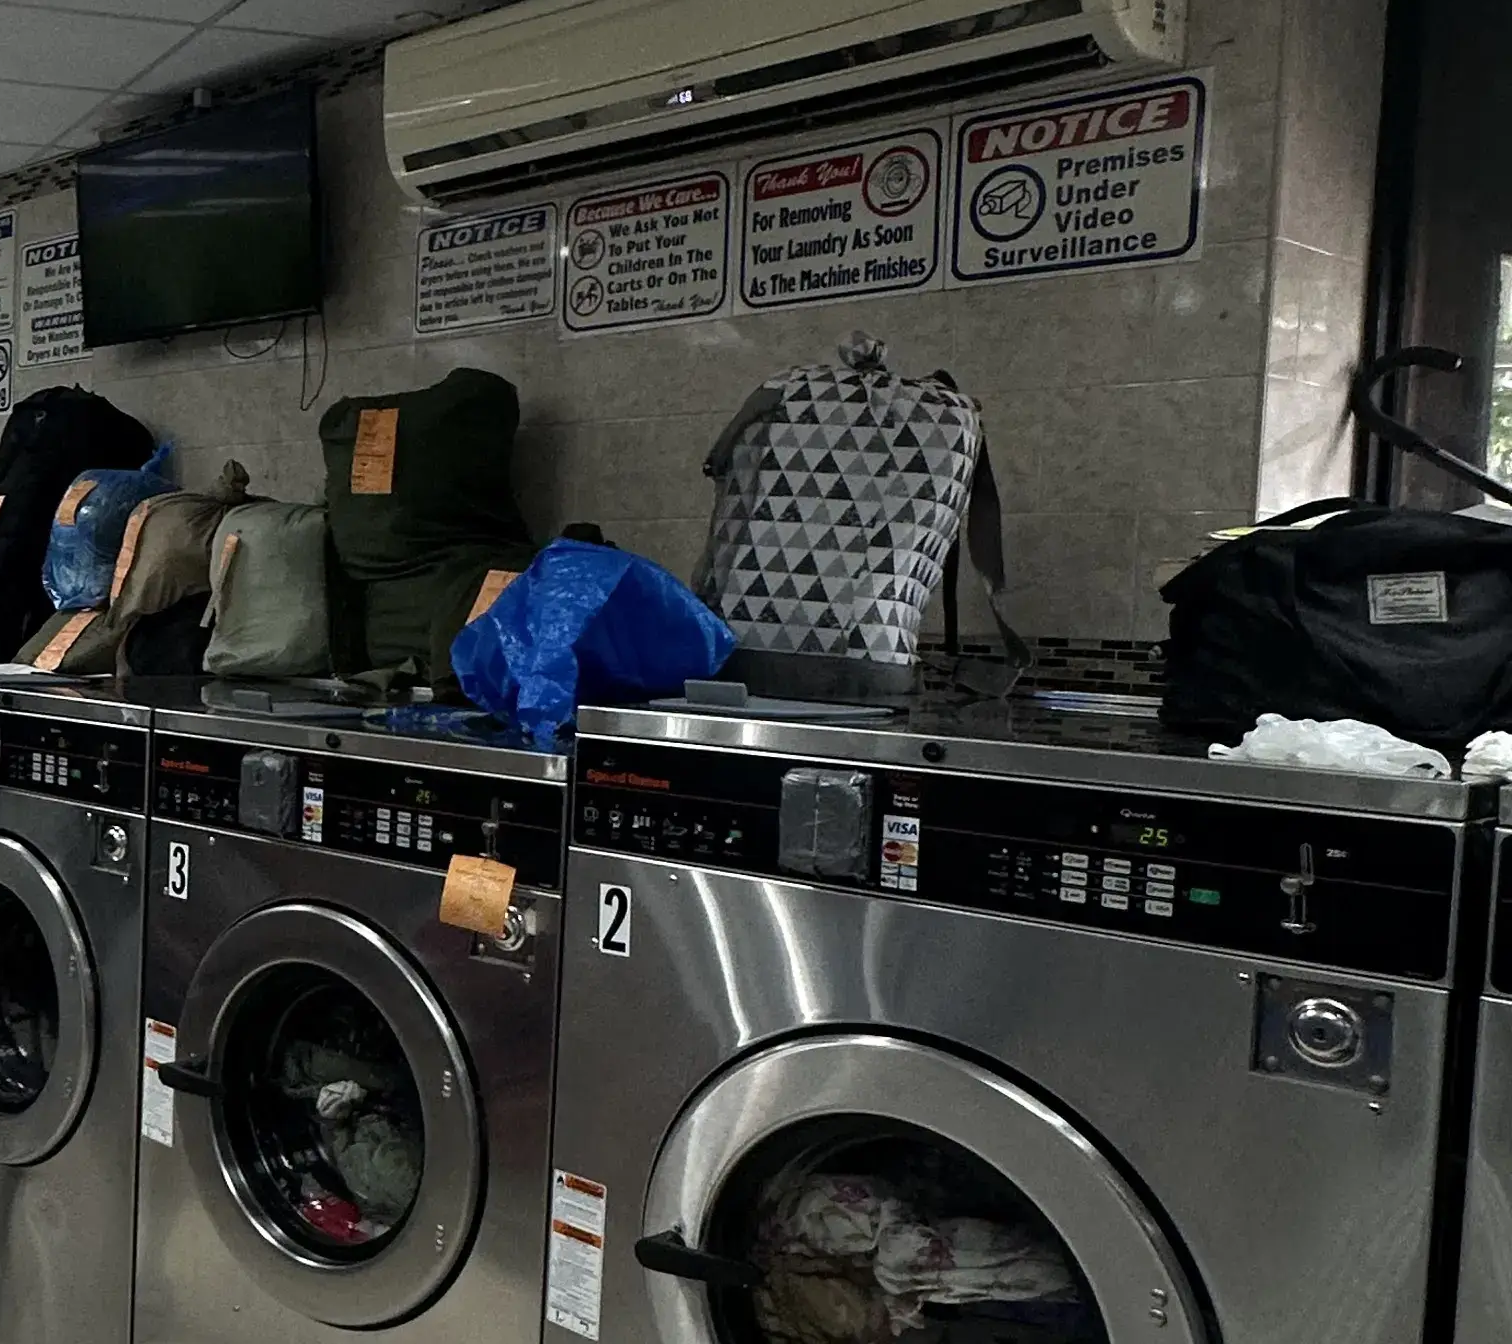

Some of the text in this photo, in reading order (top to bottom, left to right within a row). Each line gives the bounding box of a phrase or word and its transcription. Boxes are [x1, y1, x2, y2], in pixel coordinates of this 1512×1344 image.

[980, 96, 1176, 160] NOTICE
[757, 156, 861, 194] Thank You!
[1057, 144, 1185, 180] Premises
[577, 187, 717, 224] Because We Care...
[1056, 177, 1141, 207] Under
[609, 207, 719, 238] We Ask You Not
[753, 198, 852, 233] For Removing
[1054, 207, 1134, 233] Video
[433, 212, 541, 249] NOTICE
[28, 242, 78, 265] NOTI
[608, 233, 686, 257] To Put Your
[752, 224, 913, 265] Your Laundry As Soon
[984, 231, 1157, 268] Surveillance
[58, 264, 71, 275] Are
[608, 248, 713, 275] Children In The
[27, 280, 71, 296] Responsible
[607, 267, 717, 294] Carts Or On The
[749, 256, 927, 298] As The Machine Finishes
[34, 297, 63, 310] Damage
[606, 297, 648, 313] Tables
[651, 296, 684, 313] Thank
[34, 313, 84, 329] WARNIN
[63, 344, 79, 356] Own
[306, 792, 322, 801] VISA
[888, 821, 917, 836] VISA
[1139, 827, 1168, 847] 25
[170, 845, 187, 896] 3
[602, 887, 627, 952] 2
